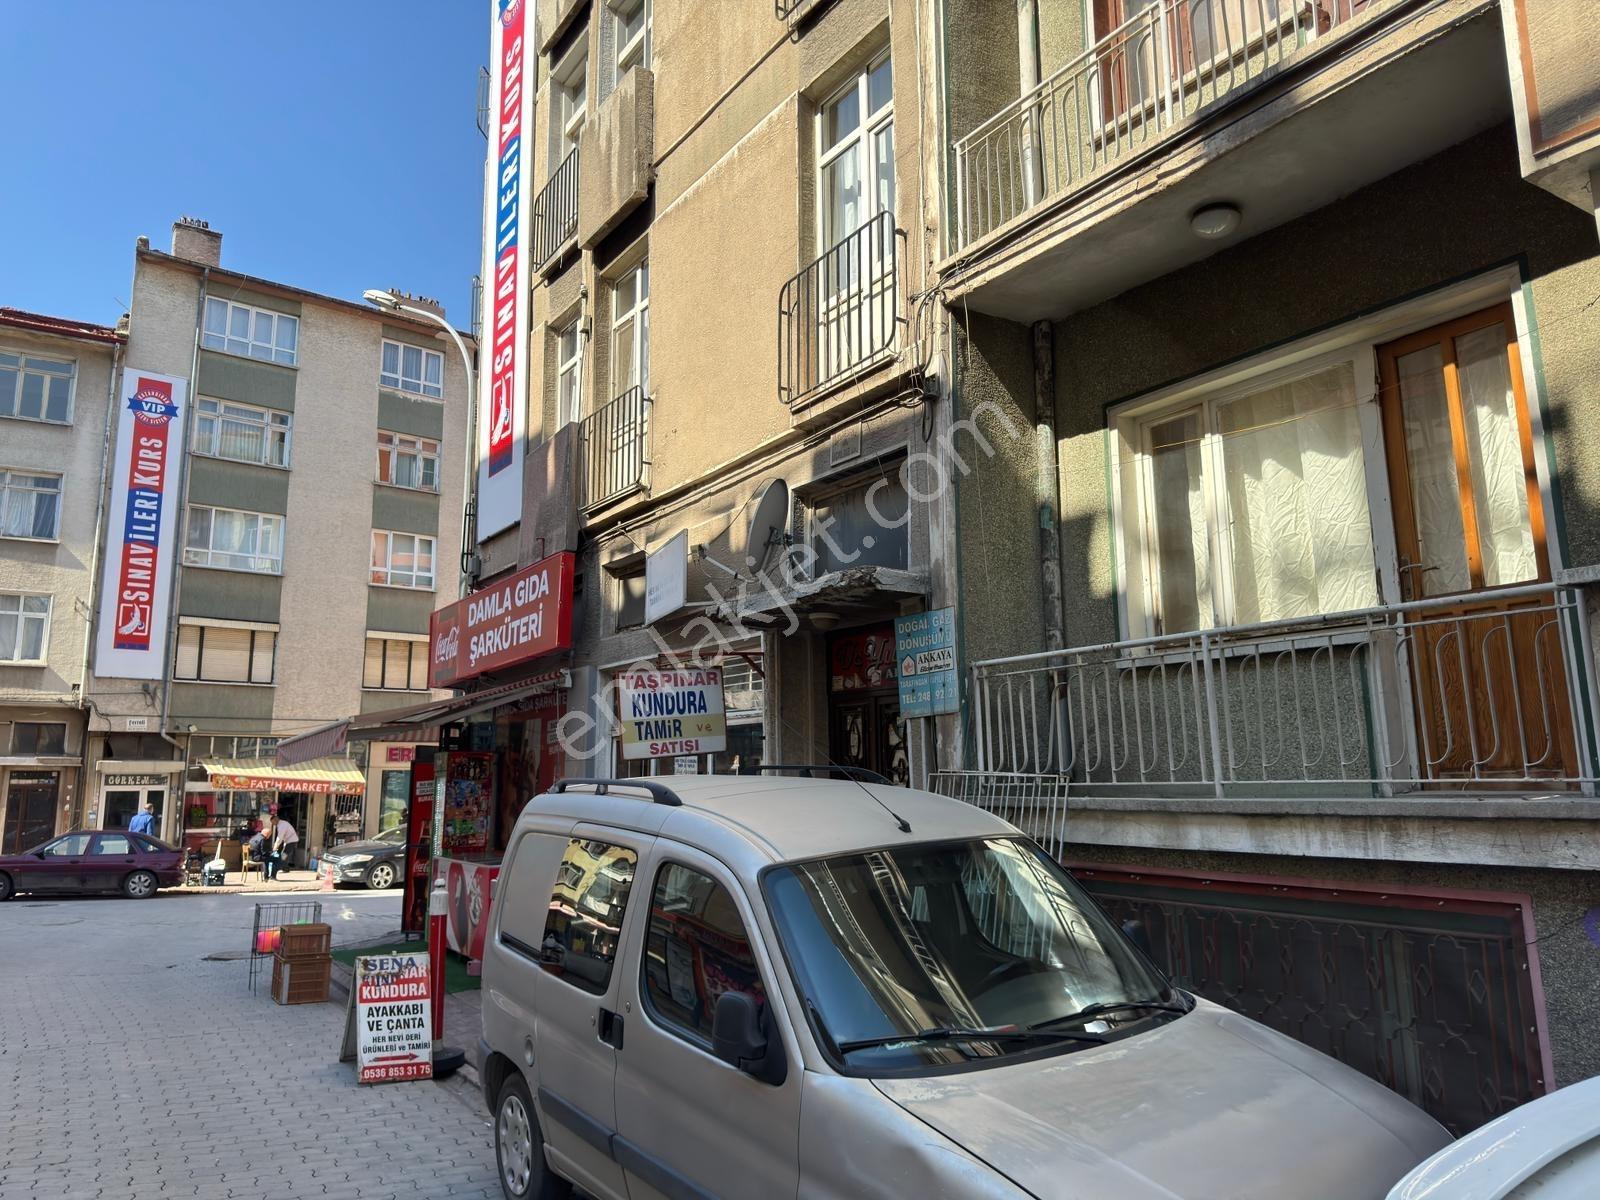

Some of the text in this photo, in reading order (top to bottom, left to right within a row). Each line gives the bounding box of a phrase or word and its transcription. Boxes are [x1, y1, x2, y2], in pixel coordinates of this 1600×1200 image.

[502, 36, 522, 144] KURS
[498, 139, 518, 251] İLERİ
[494, 253, 515, 374] SINAV
[142, 402, 166, 413] VIP
[123, 437, 163, 602] SINAV İLERİ KURS
[468, 569, 549, 627] DAMLA GIDA
[470, 603, 543, 667] ŞARKÜTERİ
[918, 650, 952, 665] AKKAYA
[622, 671, 719, 693] TAŞPINAR
[632, 690, 707, 718] KUNDURA
[696, 723, 712, 732] ve
[649, 740, 699, 756] SATIŞI
[285, 782, 330, 793] MARKET
[367, 957, 417, 972] SENA
[362, 983, 427, 999] KUNDURA
[367, 1003, 423, 1018] AYAKKABI
[367, 1017, 424, 1033] VE ÇANTA
[373, 1032, 421, 1043] HER NEVİ DERİ
[362, 1044, 397, 1054] ÜRÜNLERİ
[408, 1041, 430, 1051] TAMİRİ
[364, 1065, 430, 1079] 0536 853 31 75
